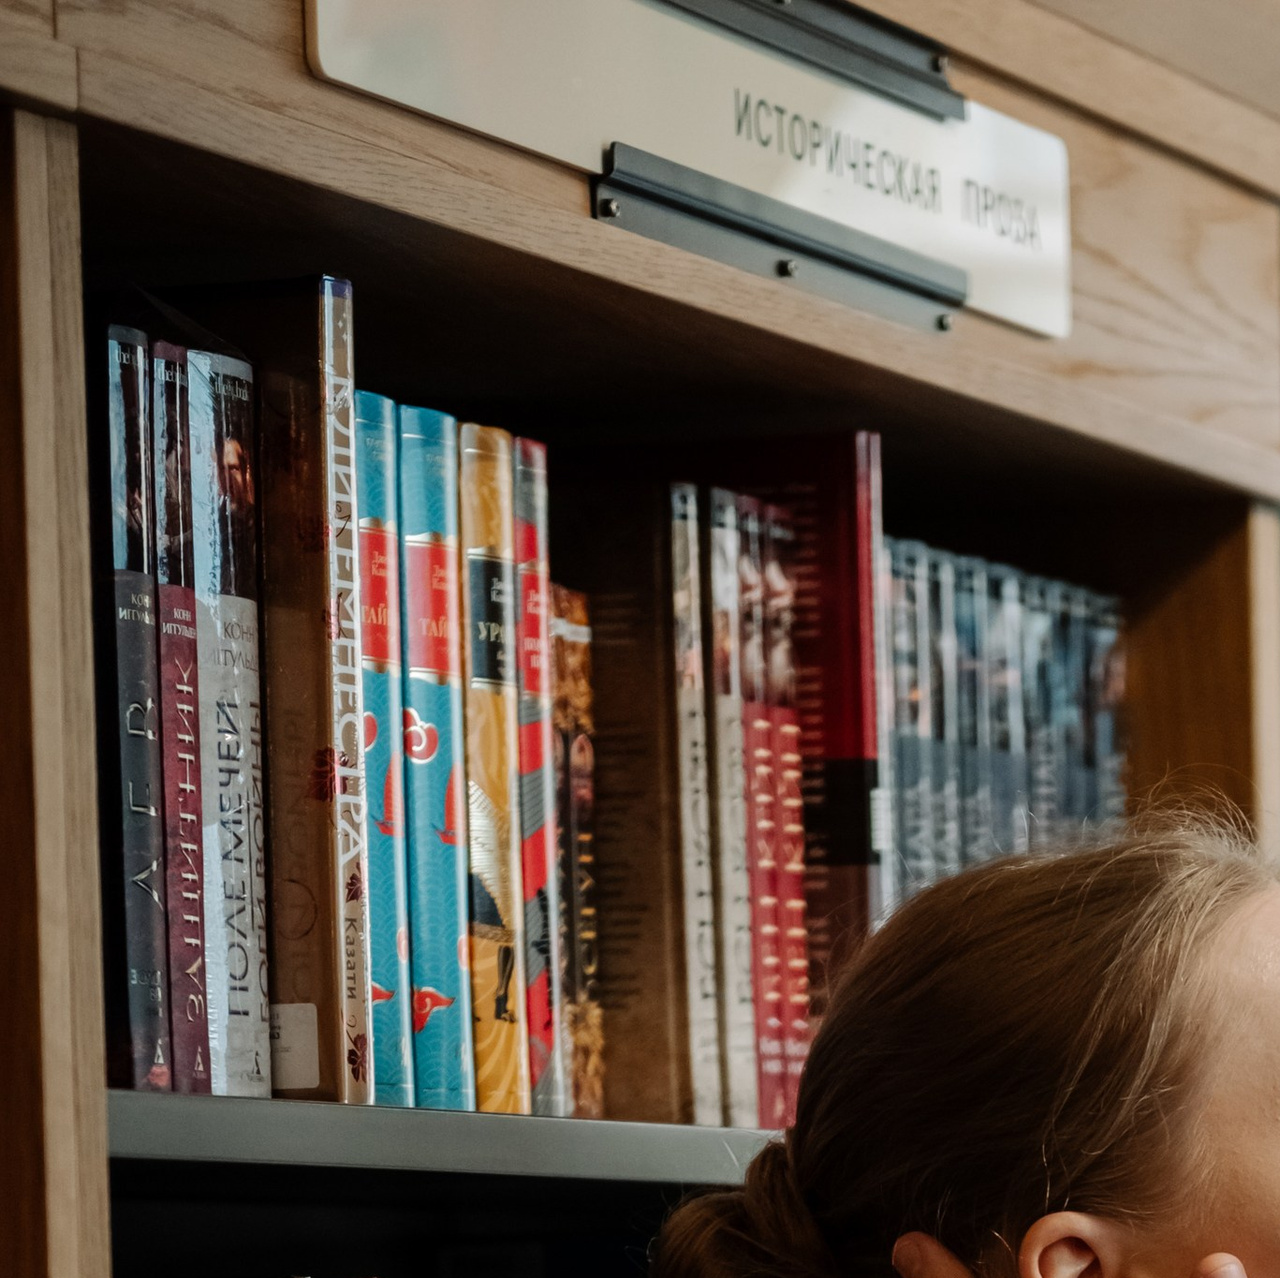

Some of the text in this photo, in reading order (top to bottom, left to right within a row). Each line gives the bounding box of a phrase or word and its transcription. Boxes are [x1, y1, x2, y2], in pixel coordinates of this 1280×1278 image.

[733, 86, 1041, 251] ИСТОРИЧЕСКАЯ ПРОЗА
[175, 657, 205, 1023] ЗАЩИТНИК
[216, 699, 249, 1016] ПОЛЕ МЕЧЕЙ
[344, 916, 358, 1001] Казати
